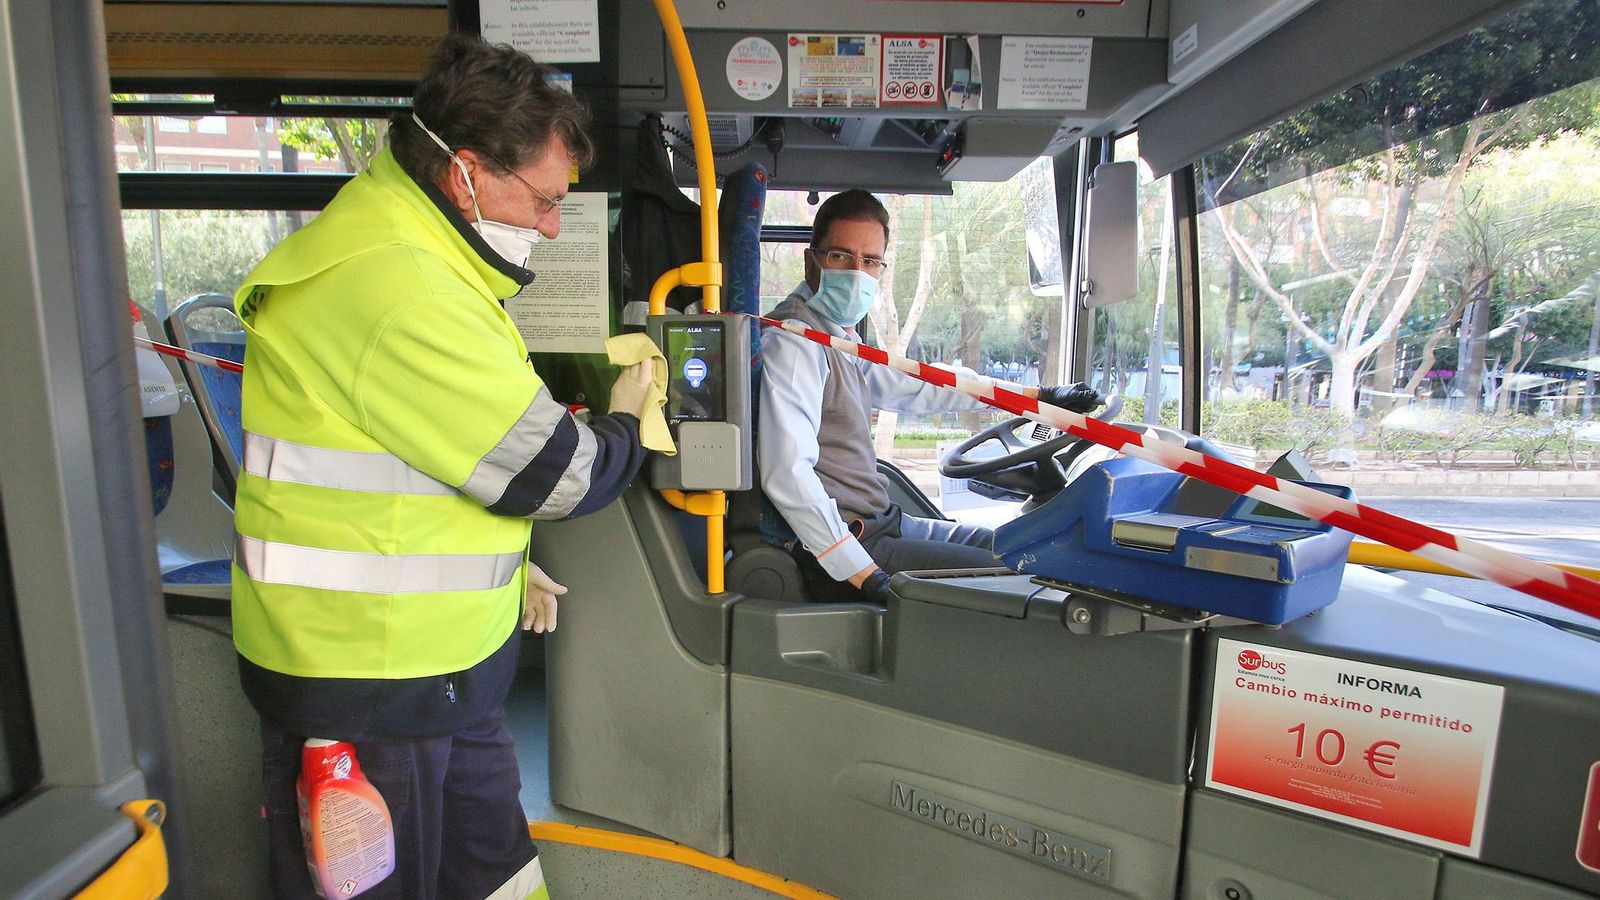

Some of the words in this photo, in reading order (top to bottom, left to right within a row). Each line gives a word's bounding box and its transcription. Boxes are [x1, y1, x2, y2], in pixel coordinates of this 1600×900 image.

[1235, 677, 1297, 699] Cambio
[1303, 692, 1374, 713] máximo
[1380, 706, 1473, 733] permitido
[1336, 672, 1422, 699] INFORMA
[1287, 722, 1346, 767] 10
[1363, 740, 1402, 780] €
[1305, 764, 1347, 780] moneda
[1347, 772, 1417, 798] fraccionaria
[892, 783, 1106, 878] Mercedes-Benz
